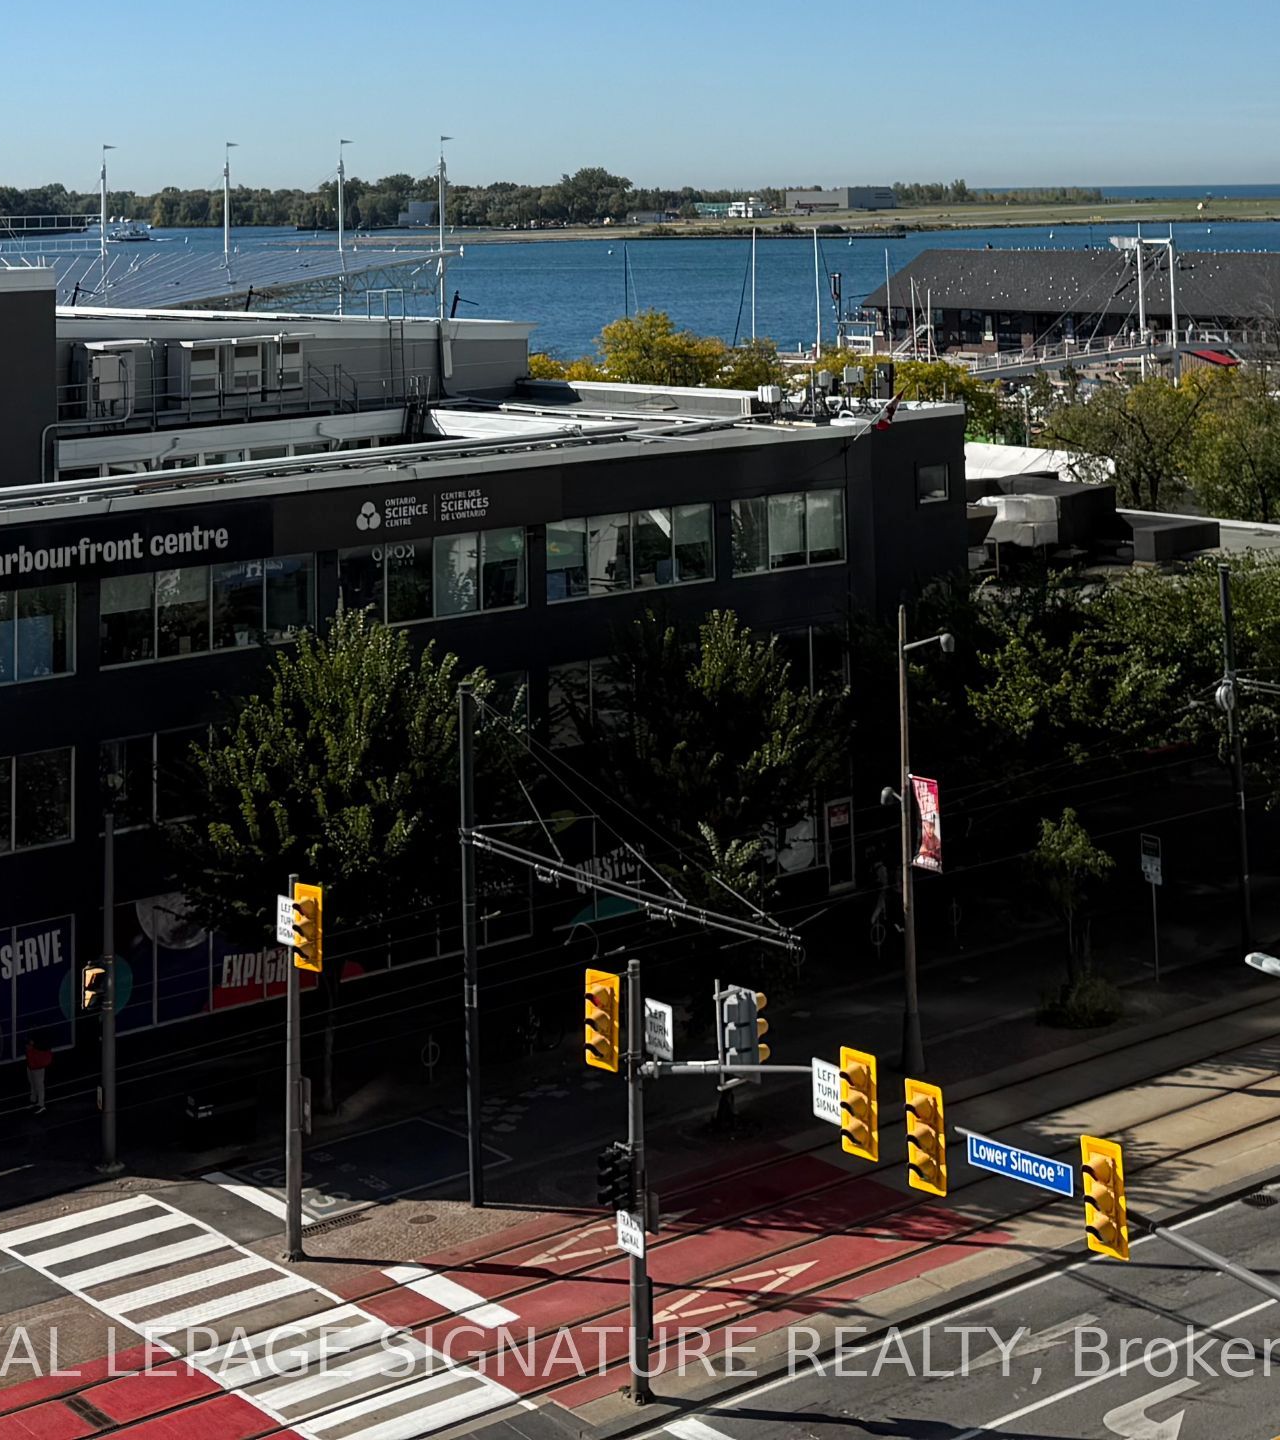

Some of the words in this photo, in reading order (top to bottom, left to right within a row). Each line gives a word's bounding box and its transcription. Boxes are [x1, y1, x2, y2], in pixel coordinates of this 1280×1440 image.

[385, 496, 417, 507] ONTARIO
[440, 491, 466, 501] CENTRE
[467, 489, 481, 498] DES
[385, 504, 429, 519] SCIENCE
[440, 497, 489, 512] SCIENCES
[385, 518, 412, 528] CENTRE
[441, 512, 450, 521] DE
[150, 525, 229, 556] centre
[221, 948, 289, 989] EXPLOR
[650, 1021, 669, 1037] TURN
[817, 1067, 836, 1085] LEFT
[817, 1082, 839, 1101] TURN
[816, 1097, 841, 1117] SIGNAL
[972, 1138, 1008, 1167] Lower
[1010, 1149, 1055, 1183] Simcoe
[1056, 1165, 1065, 1177] St
